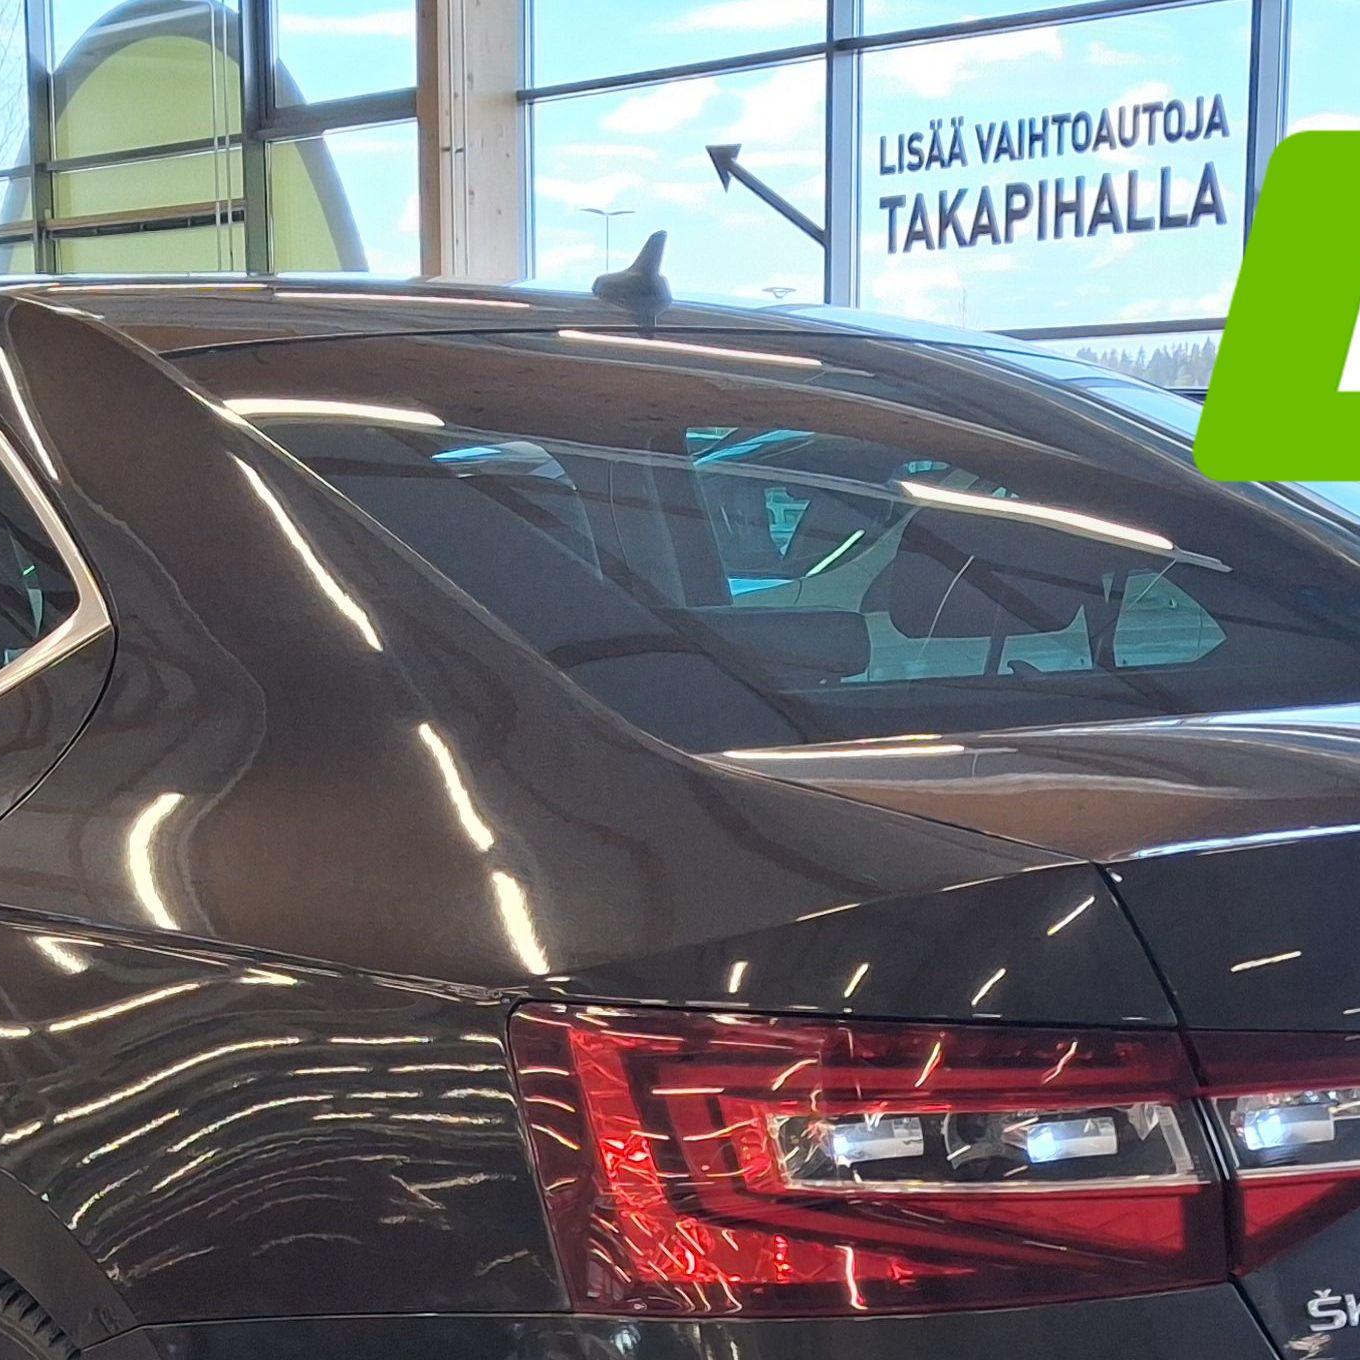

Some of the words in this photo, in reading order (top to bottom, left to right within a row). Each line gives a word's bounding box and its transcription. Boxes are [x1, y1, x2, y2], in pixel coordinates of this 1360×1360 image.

[879, 115, 968, 176] LISÄÄ
[975, 93, 1230, 164] VAIHTOAUTOJA
[878, 161, 1228, 254] TAKAPIHALLA
